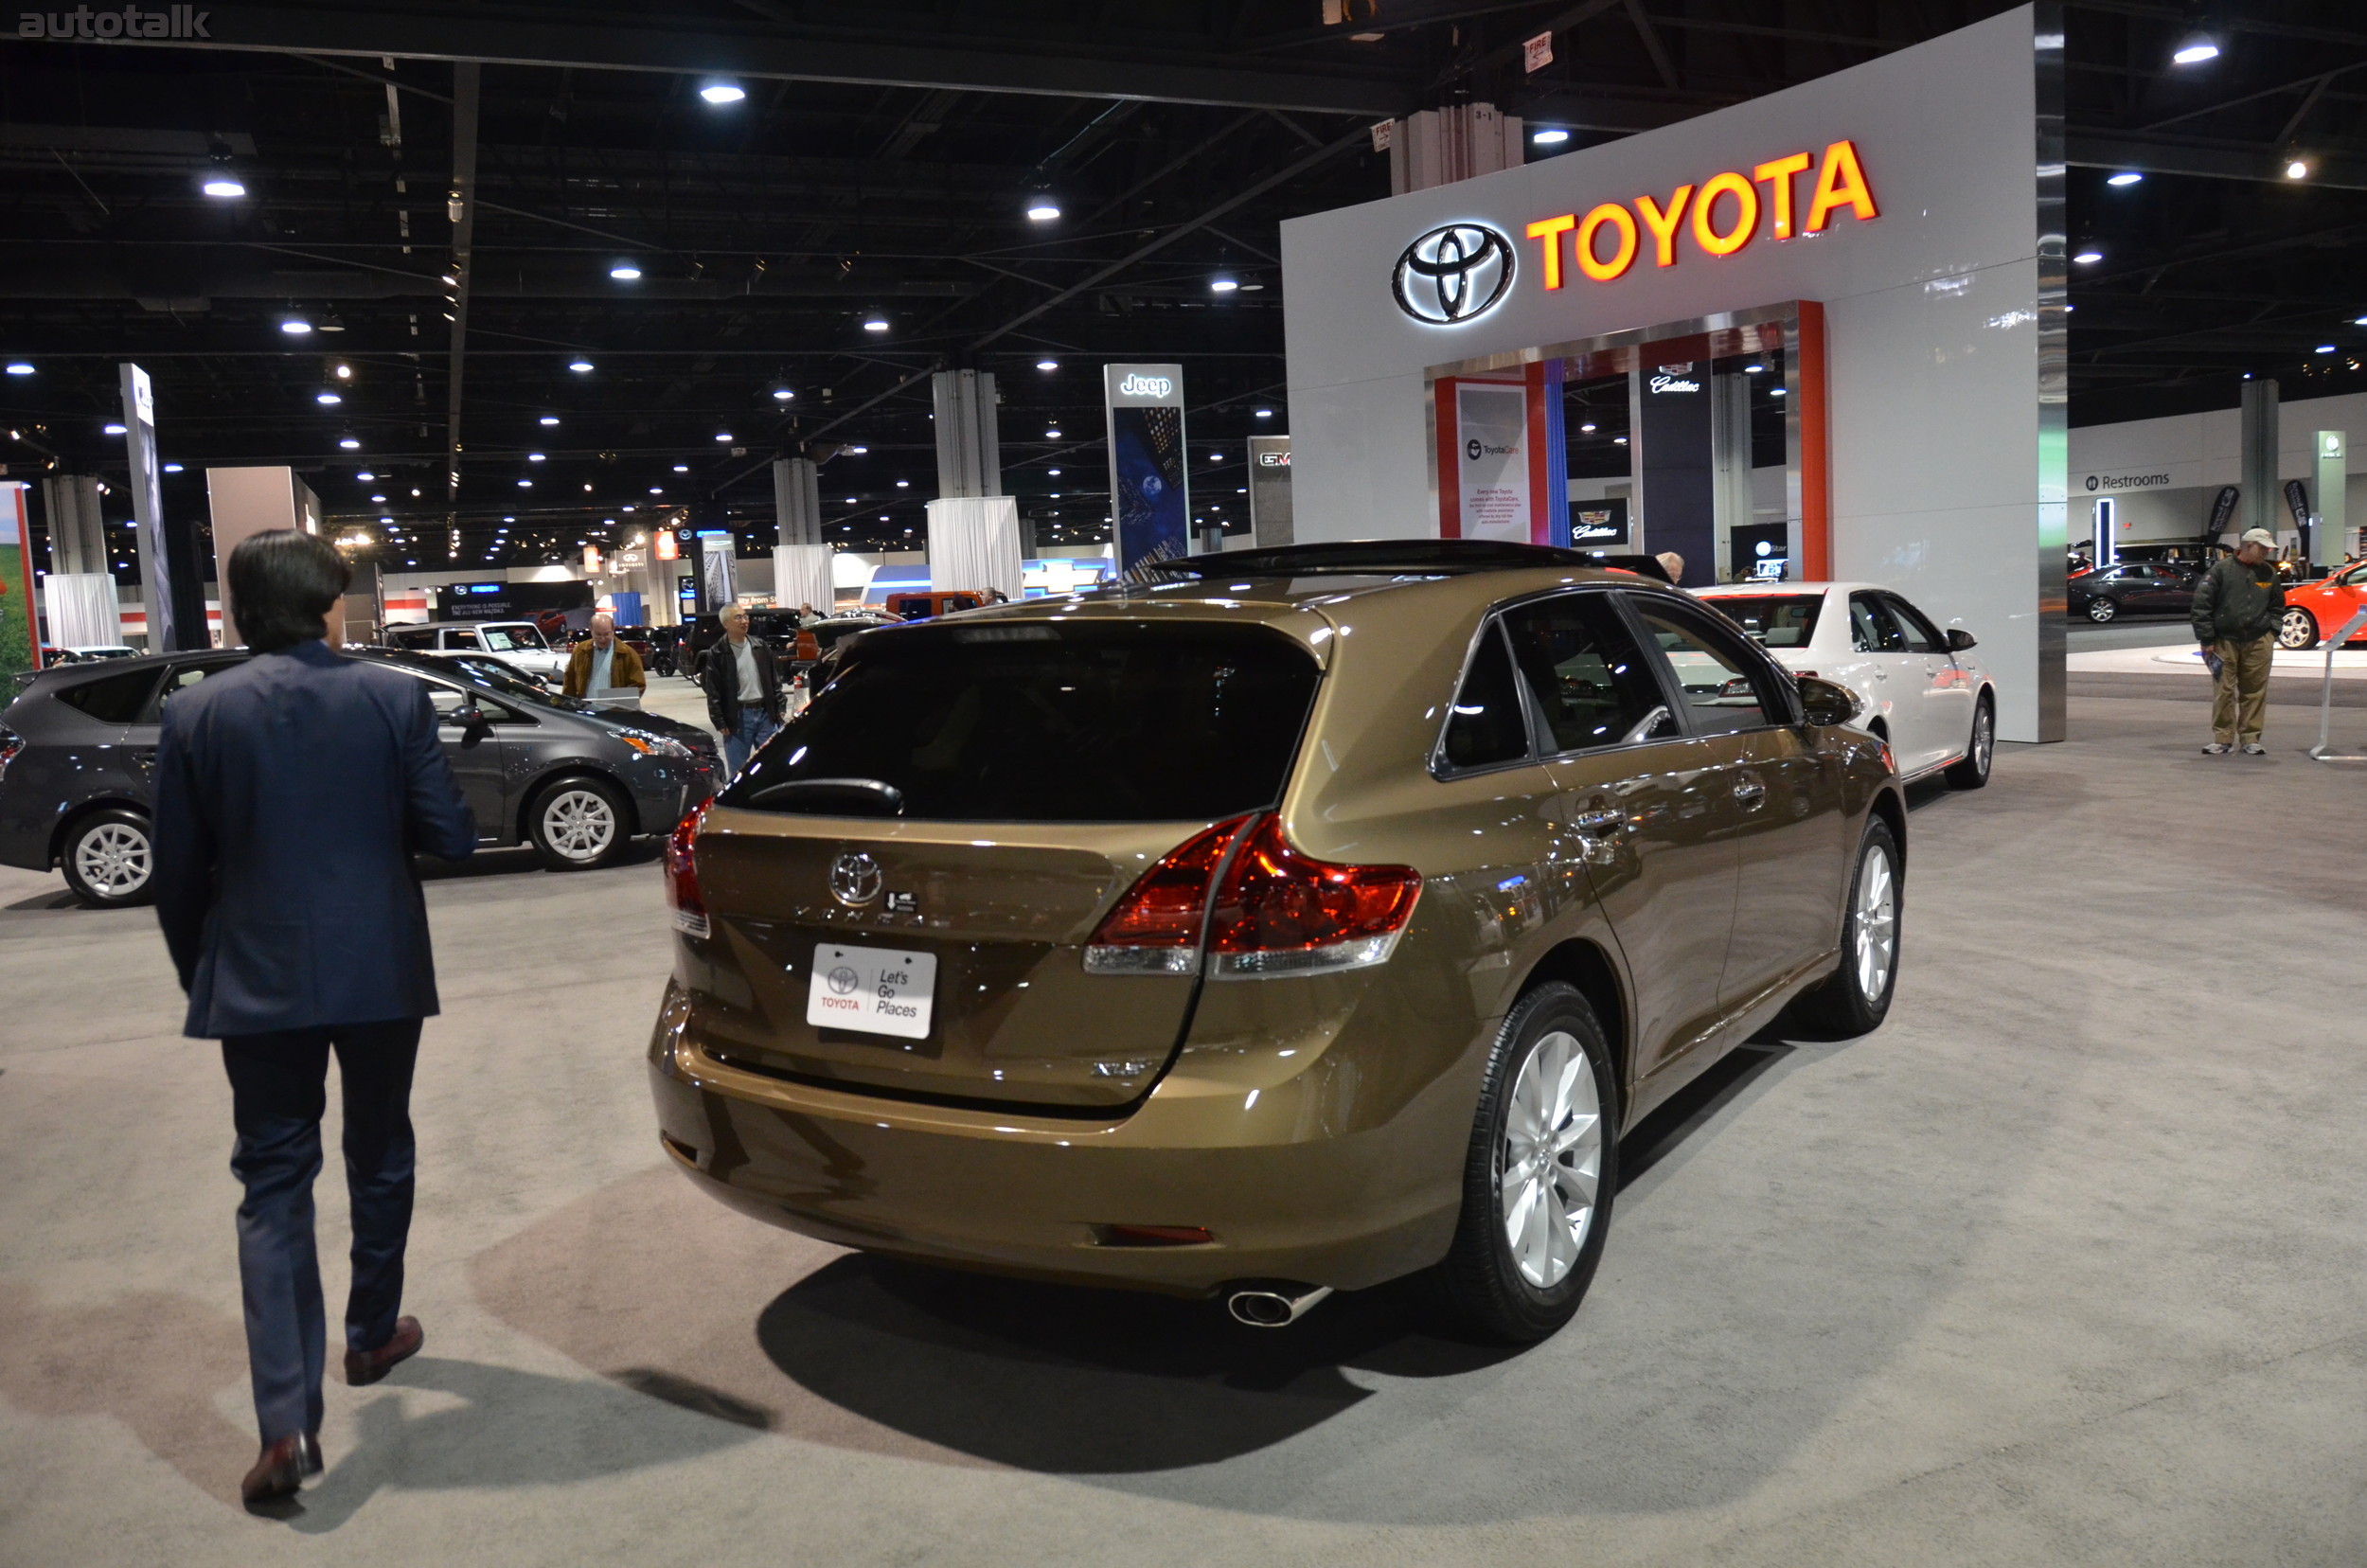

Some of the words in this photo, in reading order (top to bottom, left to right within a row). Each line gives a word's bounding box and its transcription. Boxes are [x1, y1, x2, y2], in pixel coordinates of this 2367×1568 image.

[1529, 36, 1547, 54] FIRE
[1376, 122, 1391, 136] FIRE
[1526, 139, 1881, 291] TOYOTA
[1121, 374, 1171, 398] Jeep
[1650, 376, 1700, 394] Cadillac
[1483, 445, 1520, 455] ToyotaCare
[2102, 473, 2170, 490] Restrooms
[1573, 525, 1617, 540] Cadillac
[880, 969, 909, 986] Let's
[878, 985, 895, 999] Go
[821, 997, 860, 1011] TOYOTA
[876, 1001, 917, 1018] Places
